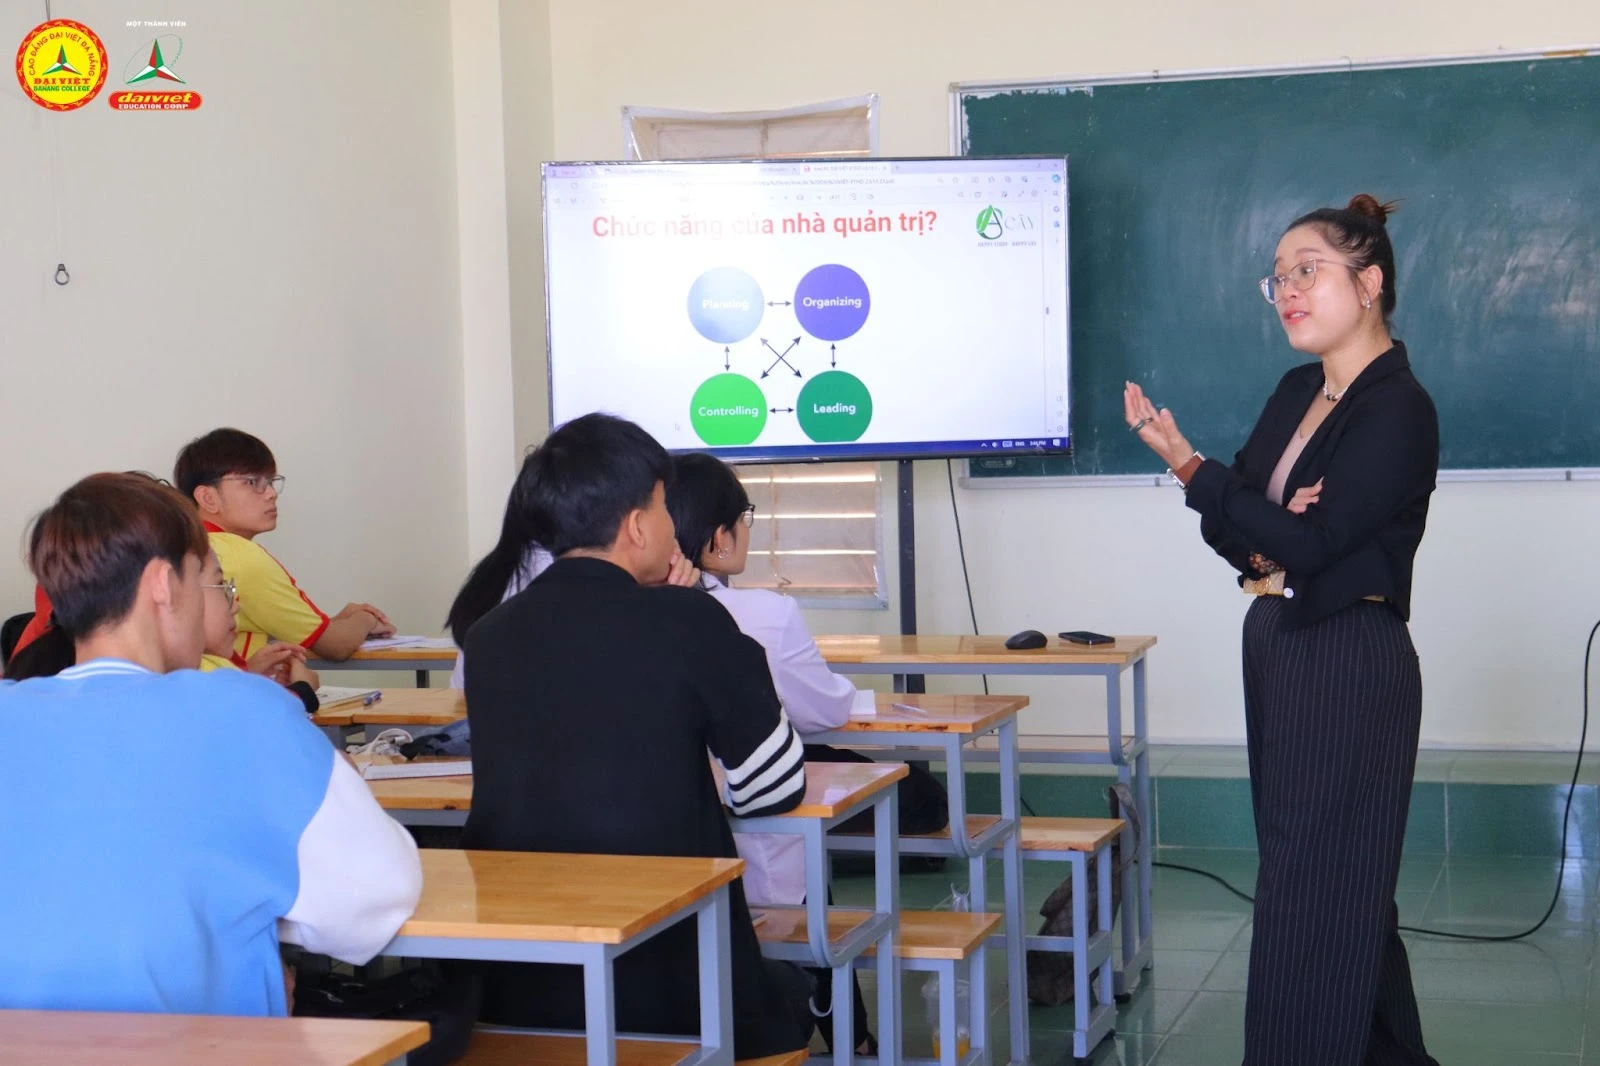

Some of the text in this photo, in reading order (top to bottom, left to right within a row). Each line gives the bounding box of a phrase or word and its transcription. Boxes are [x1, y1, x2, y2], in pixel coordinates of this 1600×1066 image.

[782, 212, 826, 234] nhà
[833, 209, 892, 238] quản
[899, 210, 937, 236] trị?
[702, 299, 750, 312] Planning
[802, 296, 862, 310] Organizing
[698, 405, 759, 418] Controlling
[813, 402, 856, 416] Leading
